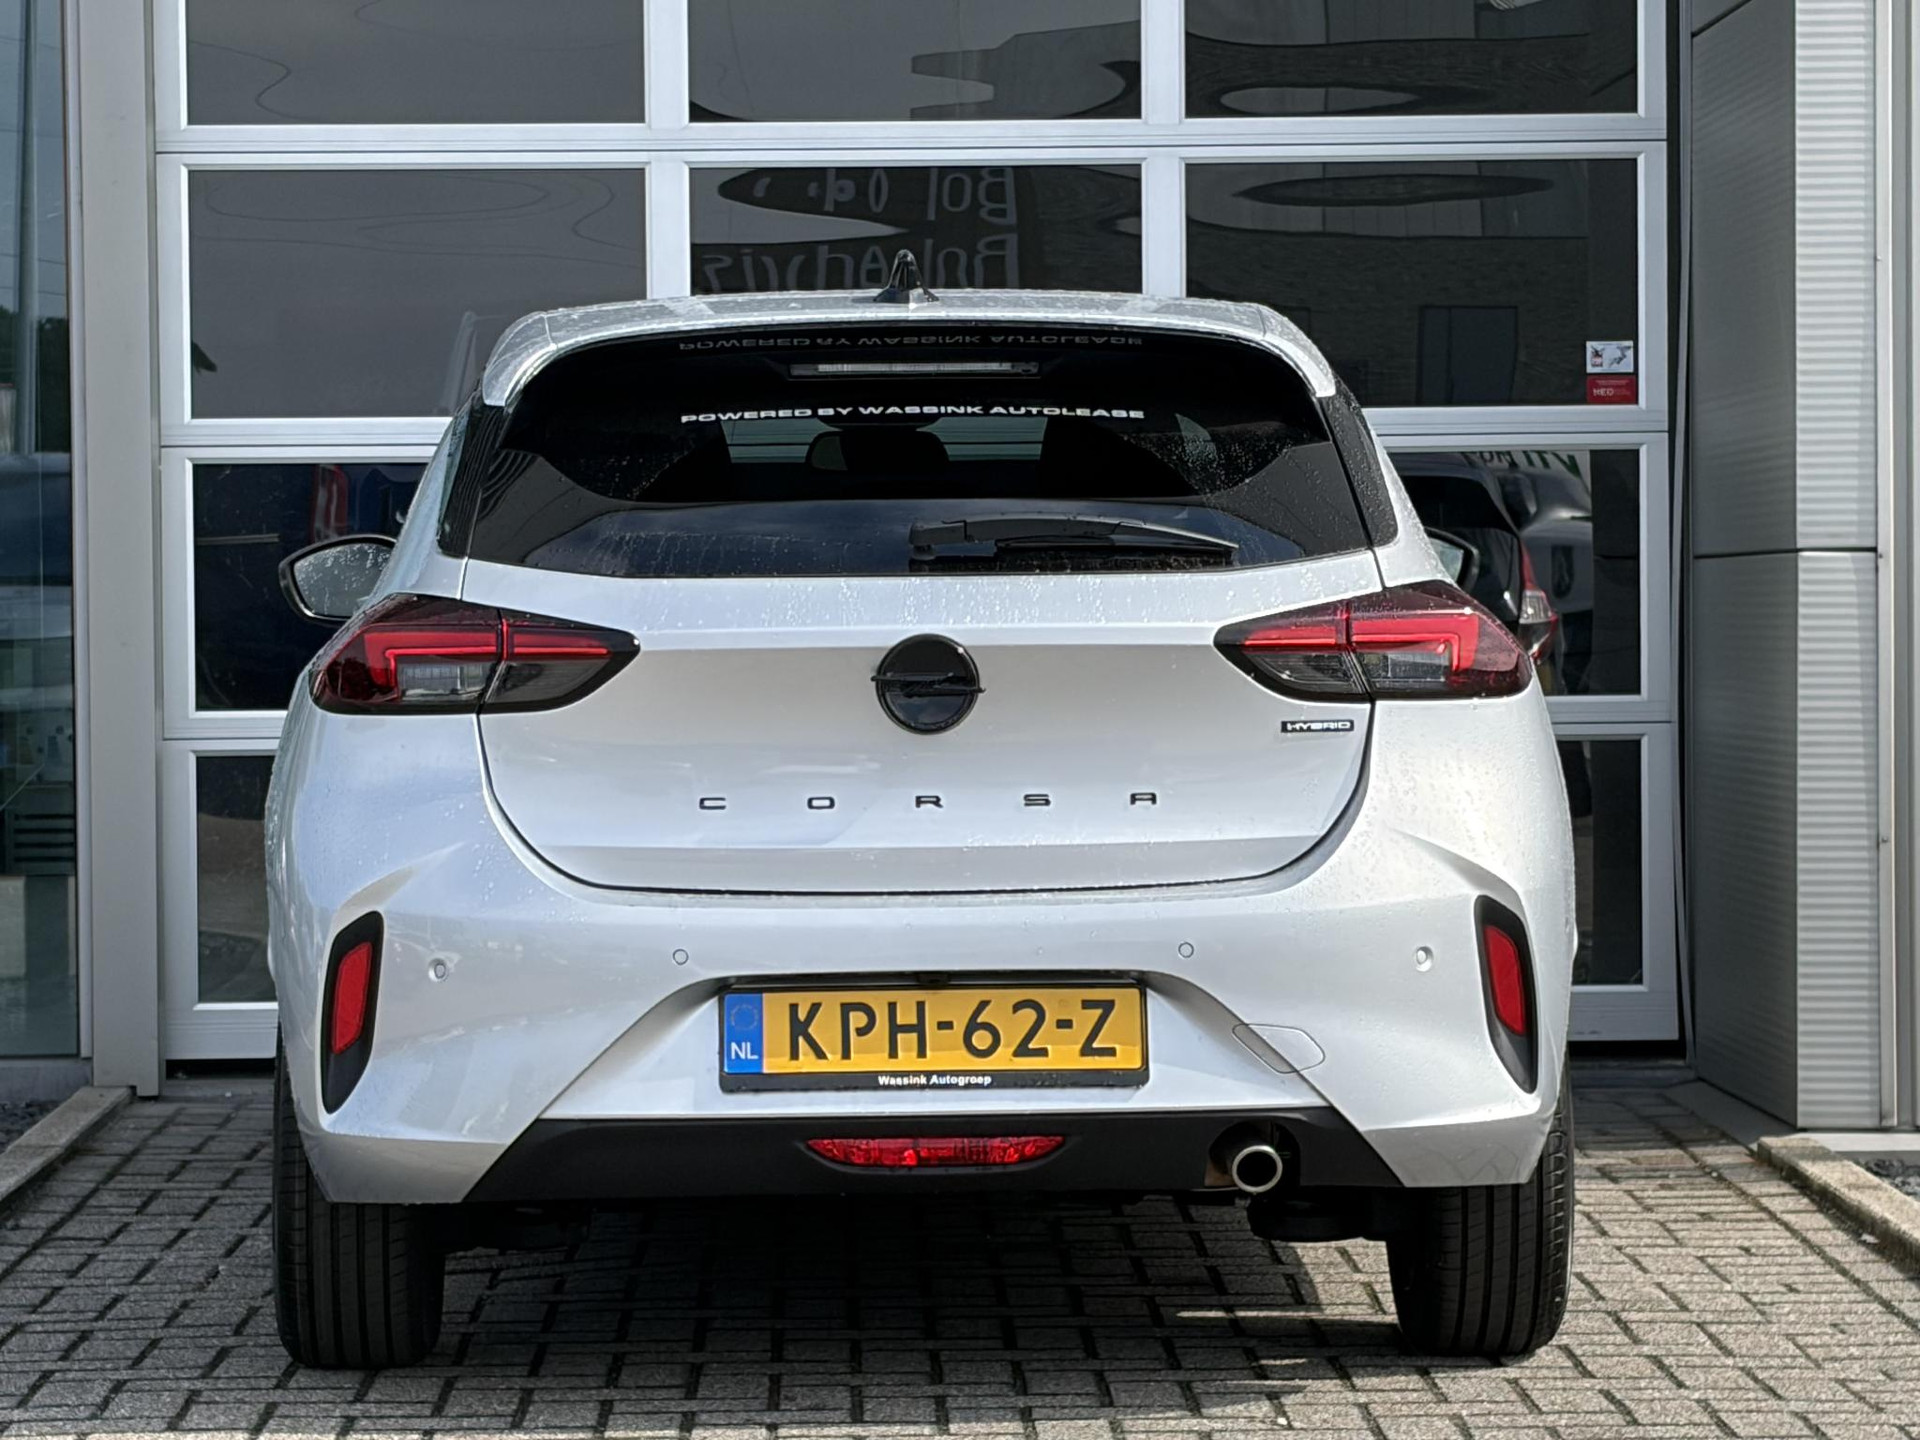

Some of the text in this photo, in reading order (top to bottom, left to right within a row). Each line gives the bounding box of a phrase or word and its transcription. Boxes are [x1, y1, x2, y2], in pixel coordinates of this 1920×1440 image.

[681, 406, 1145, 423] POWERED BY WASSINK AUTOLEASE
[1286, 721, 1351, 731] HYBRID
[699, 792, 1157, 810] CORSA
[788, 998, 1118, 1061] KPH-62-Z
[730, 1041, 759, 1060] NL
[878, 1074, 992, 1087] Wassink Autogroep
